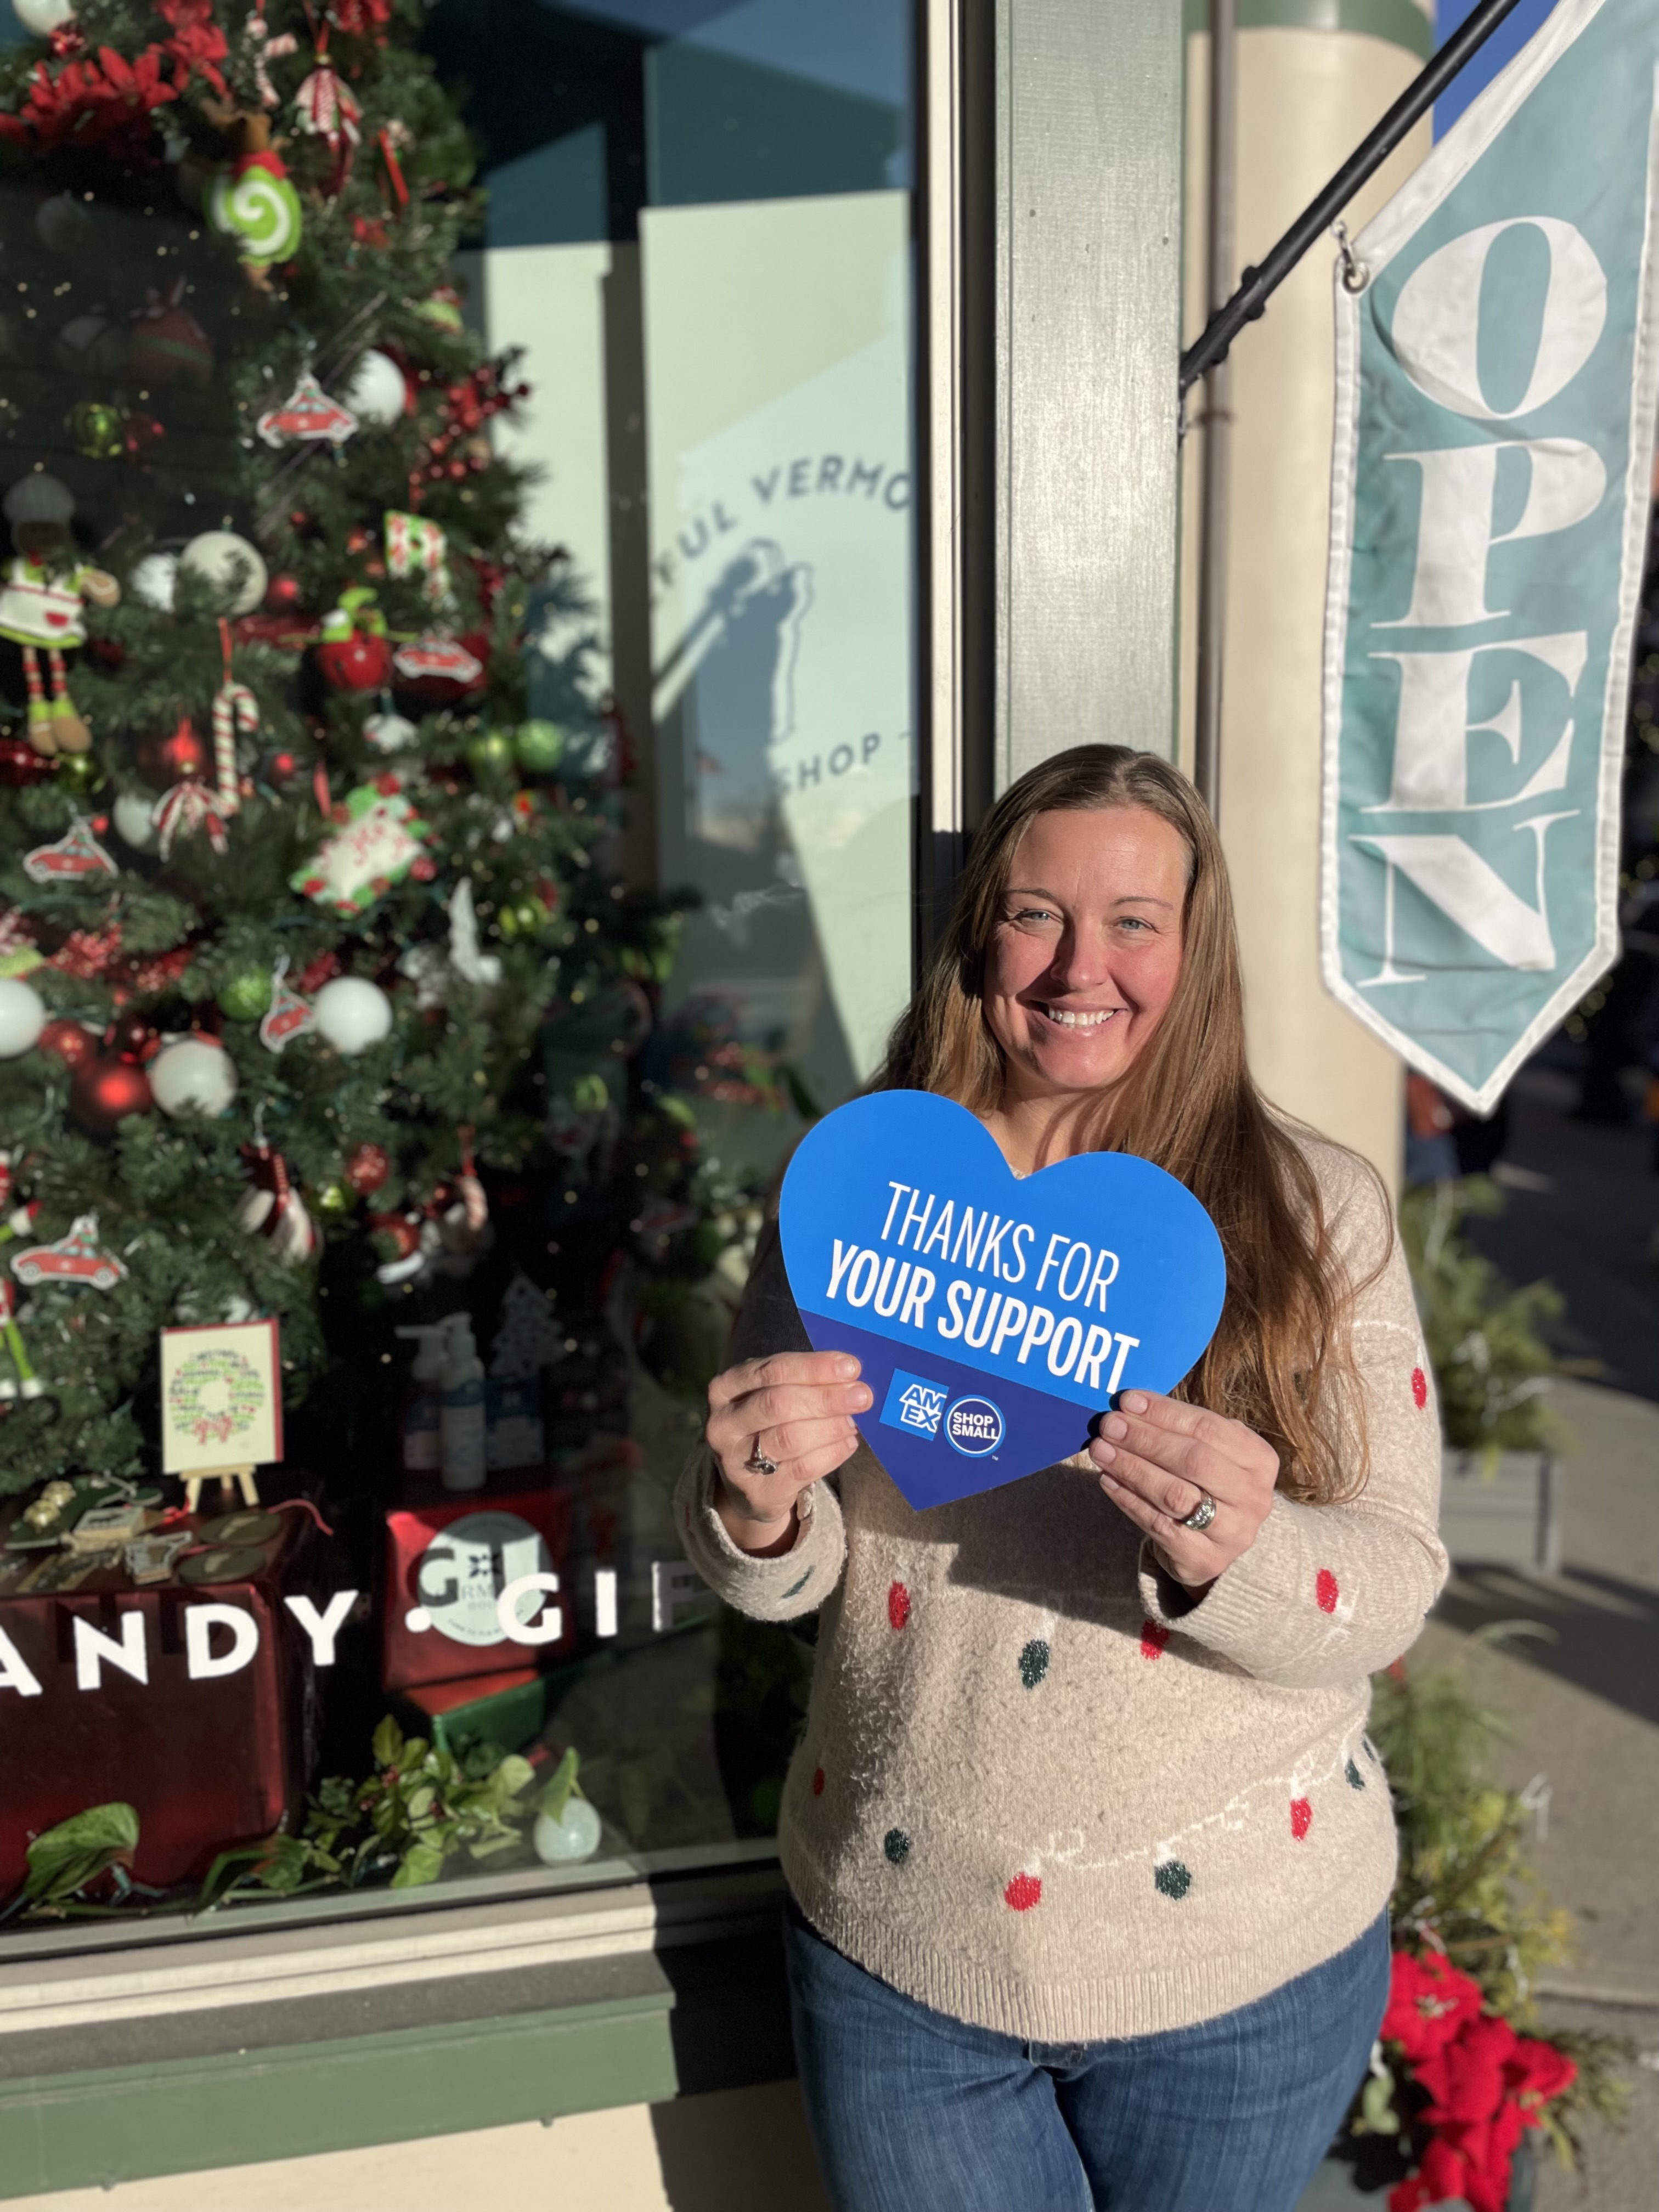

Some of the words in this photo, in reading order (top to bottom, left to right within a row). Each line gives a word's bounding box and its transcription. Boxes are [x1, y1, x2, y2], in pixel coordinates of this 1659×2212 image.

[1348, 216, 1608, 988] OPEN
[881, 1181, 1035, 1283] THANKS
[1035, 1233, 1120, 1313] FOR
[826, 1238, 936, 1329] YOUR
[937, 1279, 1141, 1395] SUPPORT
[952, 1424, 1000, 1440] SMALL
[953, 1412, 994, 1426] SHOP
